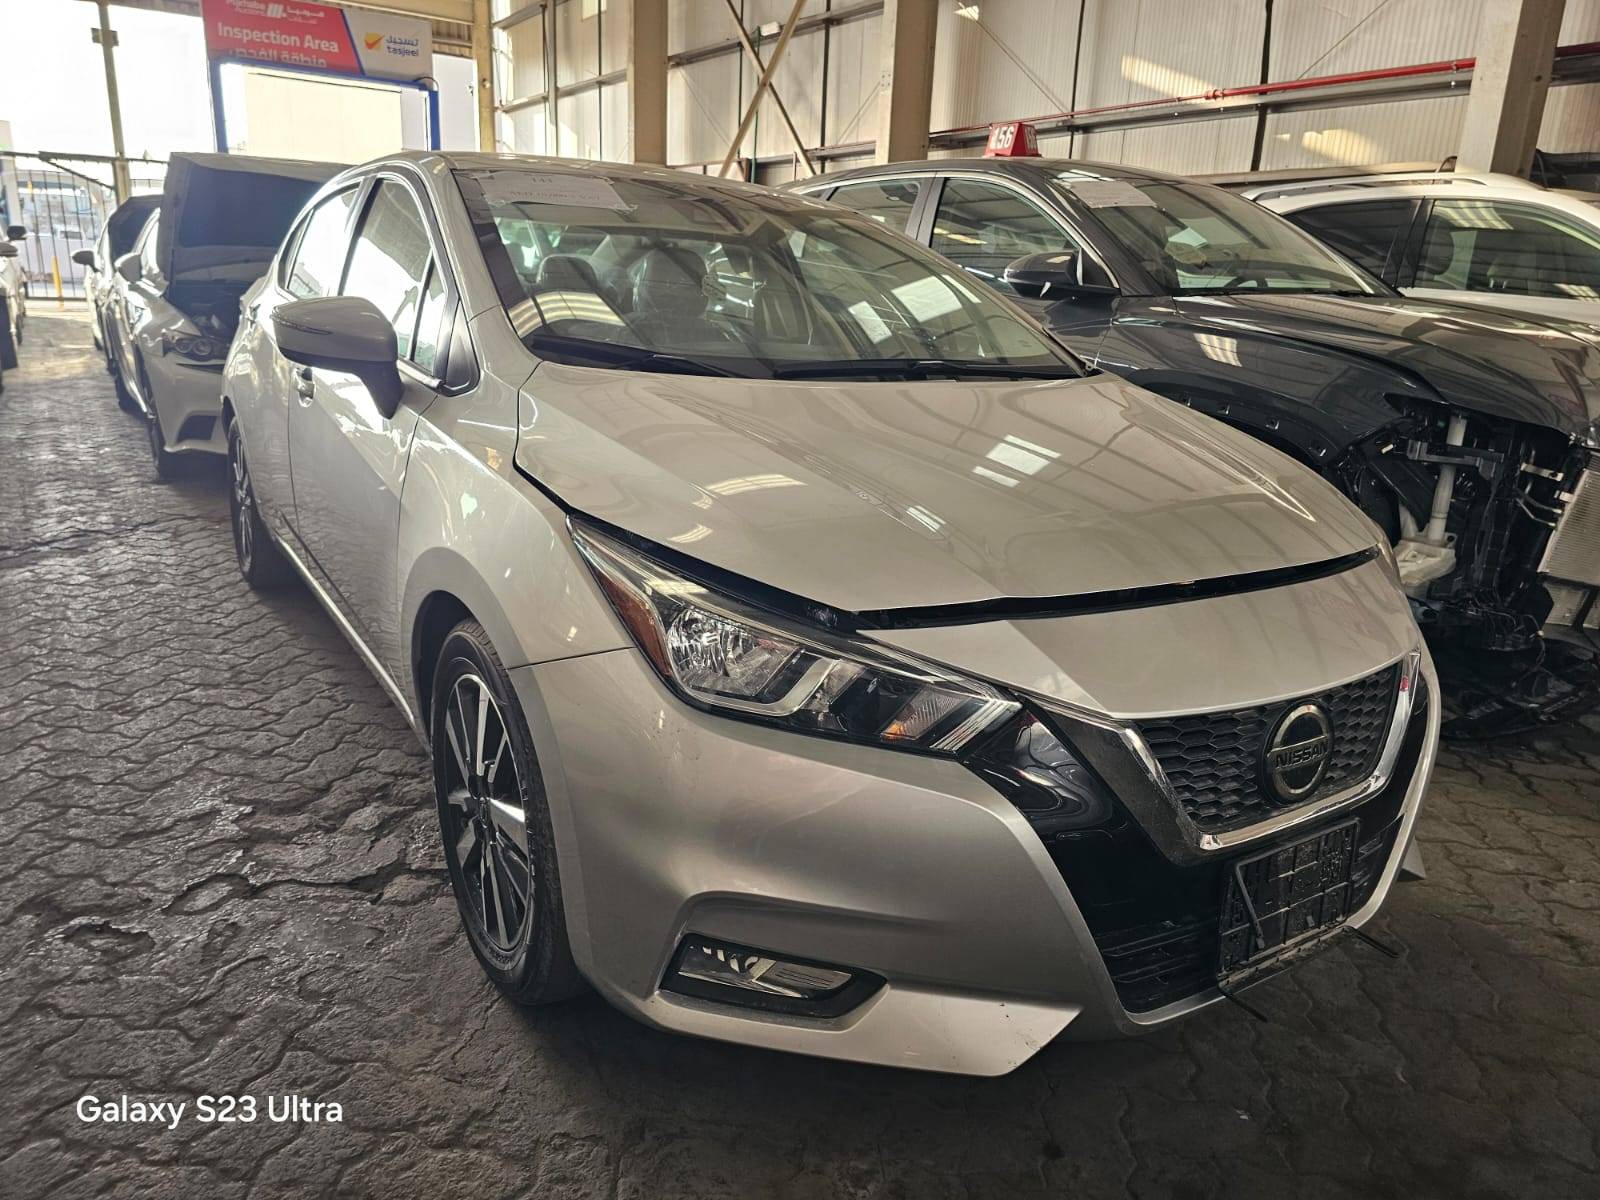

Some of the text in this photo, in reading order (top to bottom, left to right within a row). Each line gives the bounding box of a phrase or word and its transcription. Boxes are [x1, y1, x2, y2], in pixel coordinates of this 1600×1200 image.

[217, 22, 339, 53] Inspection Area
[387, 46, 419, 58] tasjeel
[1275, 740, 1328, 769] NISSAN
